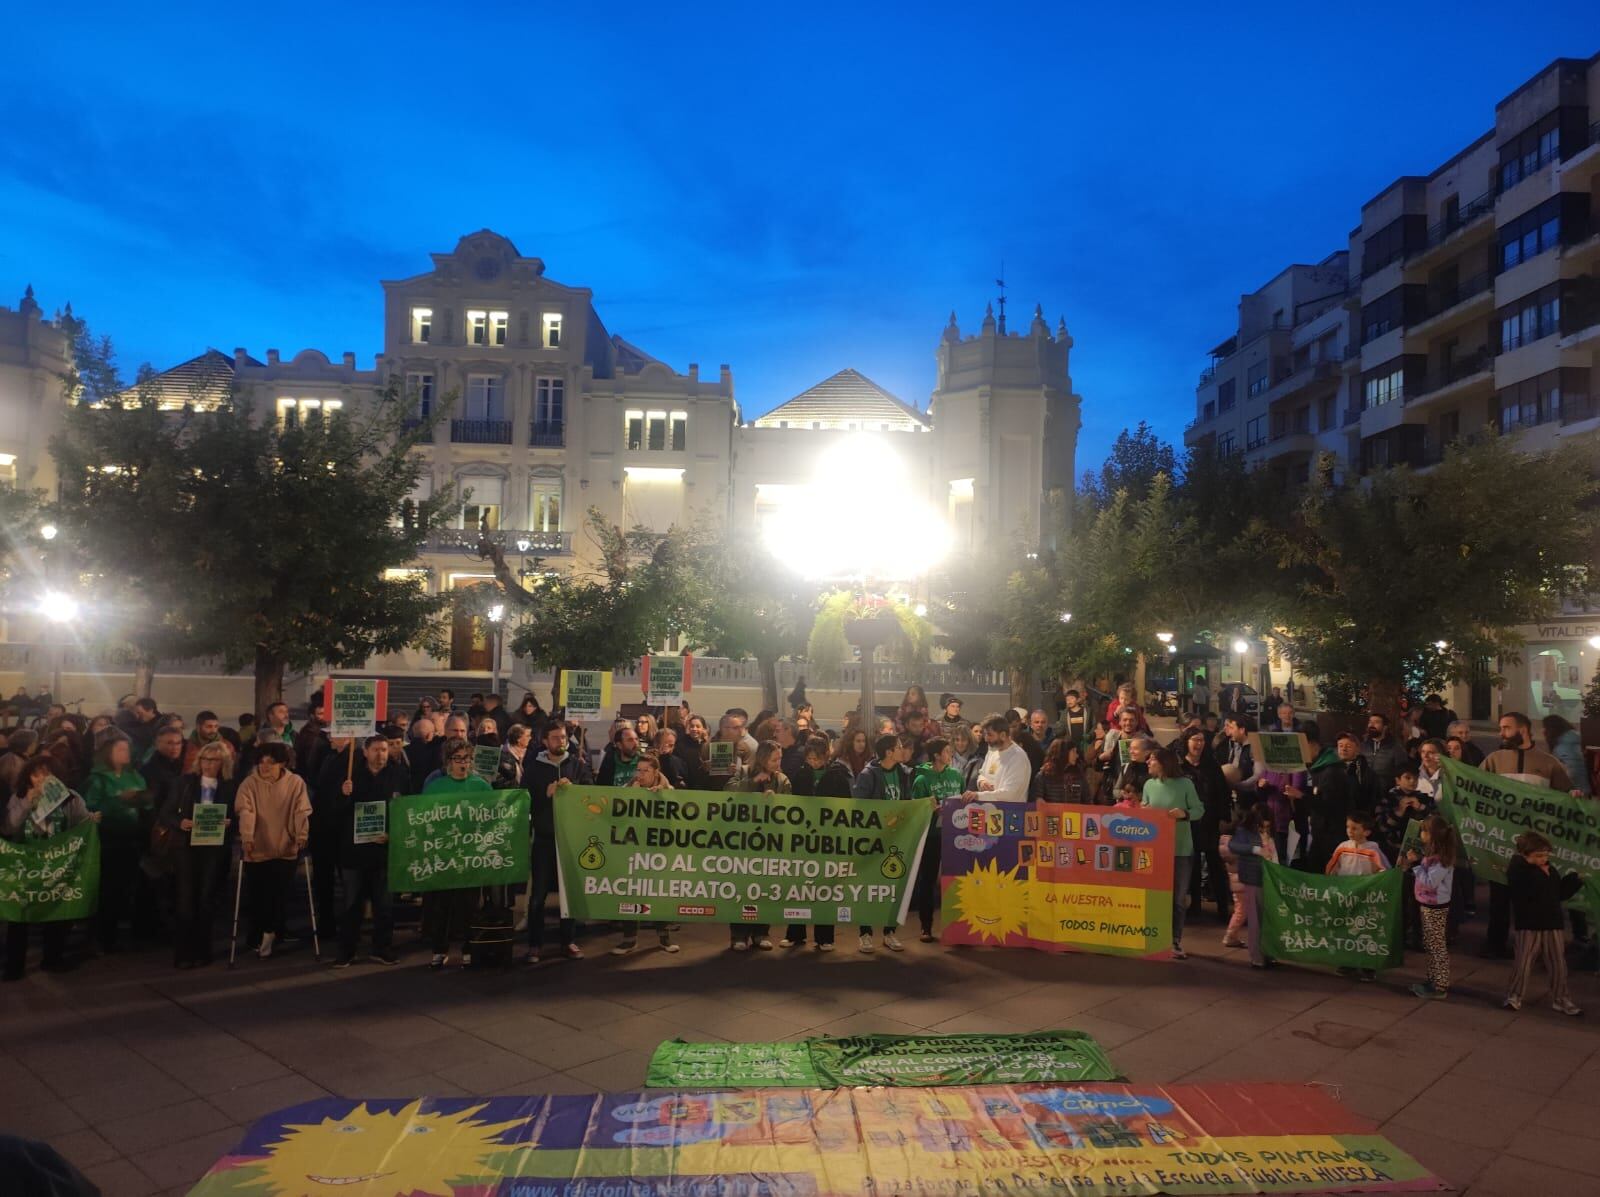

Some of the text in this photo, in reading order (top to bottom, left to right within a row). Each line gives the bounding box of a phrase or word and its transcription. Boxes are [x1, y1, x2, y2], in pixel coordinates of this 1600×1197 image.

[577, 674, 593, 688] NO!
[1455, 775, 1517, 806] DINERO
[408, 803, 463, 826] ESCUELA
[467, 803, 518, 822] PÚBLICA:
[611, 797, 882, 829] DINERO PÚBLICO, PARA
[1453, 791, 1471, 810] LA
[1475, 801, 1581, 844] EDUCACIÓN
[609, 826, 885, 856] LA EDUCACIÓN PÚBLICA
[1488, 826, 1507, 842] AL
[423, 837, 444, 852] DE
[413, 856, 458, 878] PARA
[627, 852, 857, 878] ¡NO AL CONCIERTO DEL
[584, 876, 897, 904] BACHILLERATO, 0-3 AÑOS Y FP!
[1045, 893, 1058, 904] LA
[1062, 894, 1114, 906] NUESTRA
[1059, 919, 1160, 938] TODOS PINTAMOS
[1294, 913, 1313, 926] DE
[1284, 936, 1329, 950] PARA
[1166, 1149, 1392, 1167] TODOS PINTAMOS
[1103, 1170, 1127, 1185] de
[1157, 1169, 1235, 1185] Escuela
[1315, 1166, 1393, 1182] HUESCA
